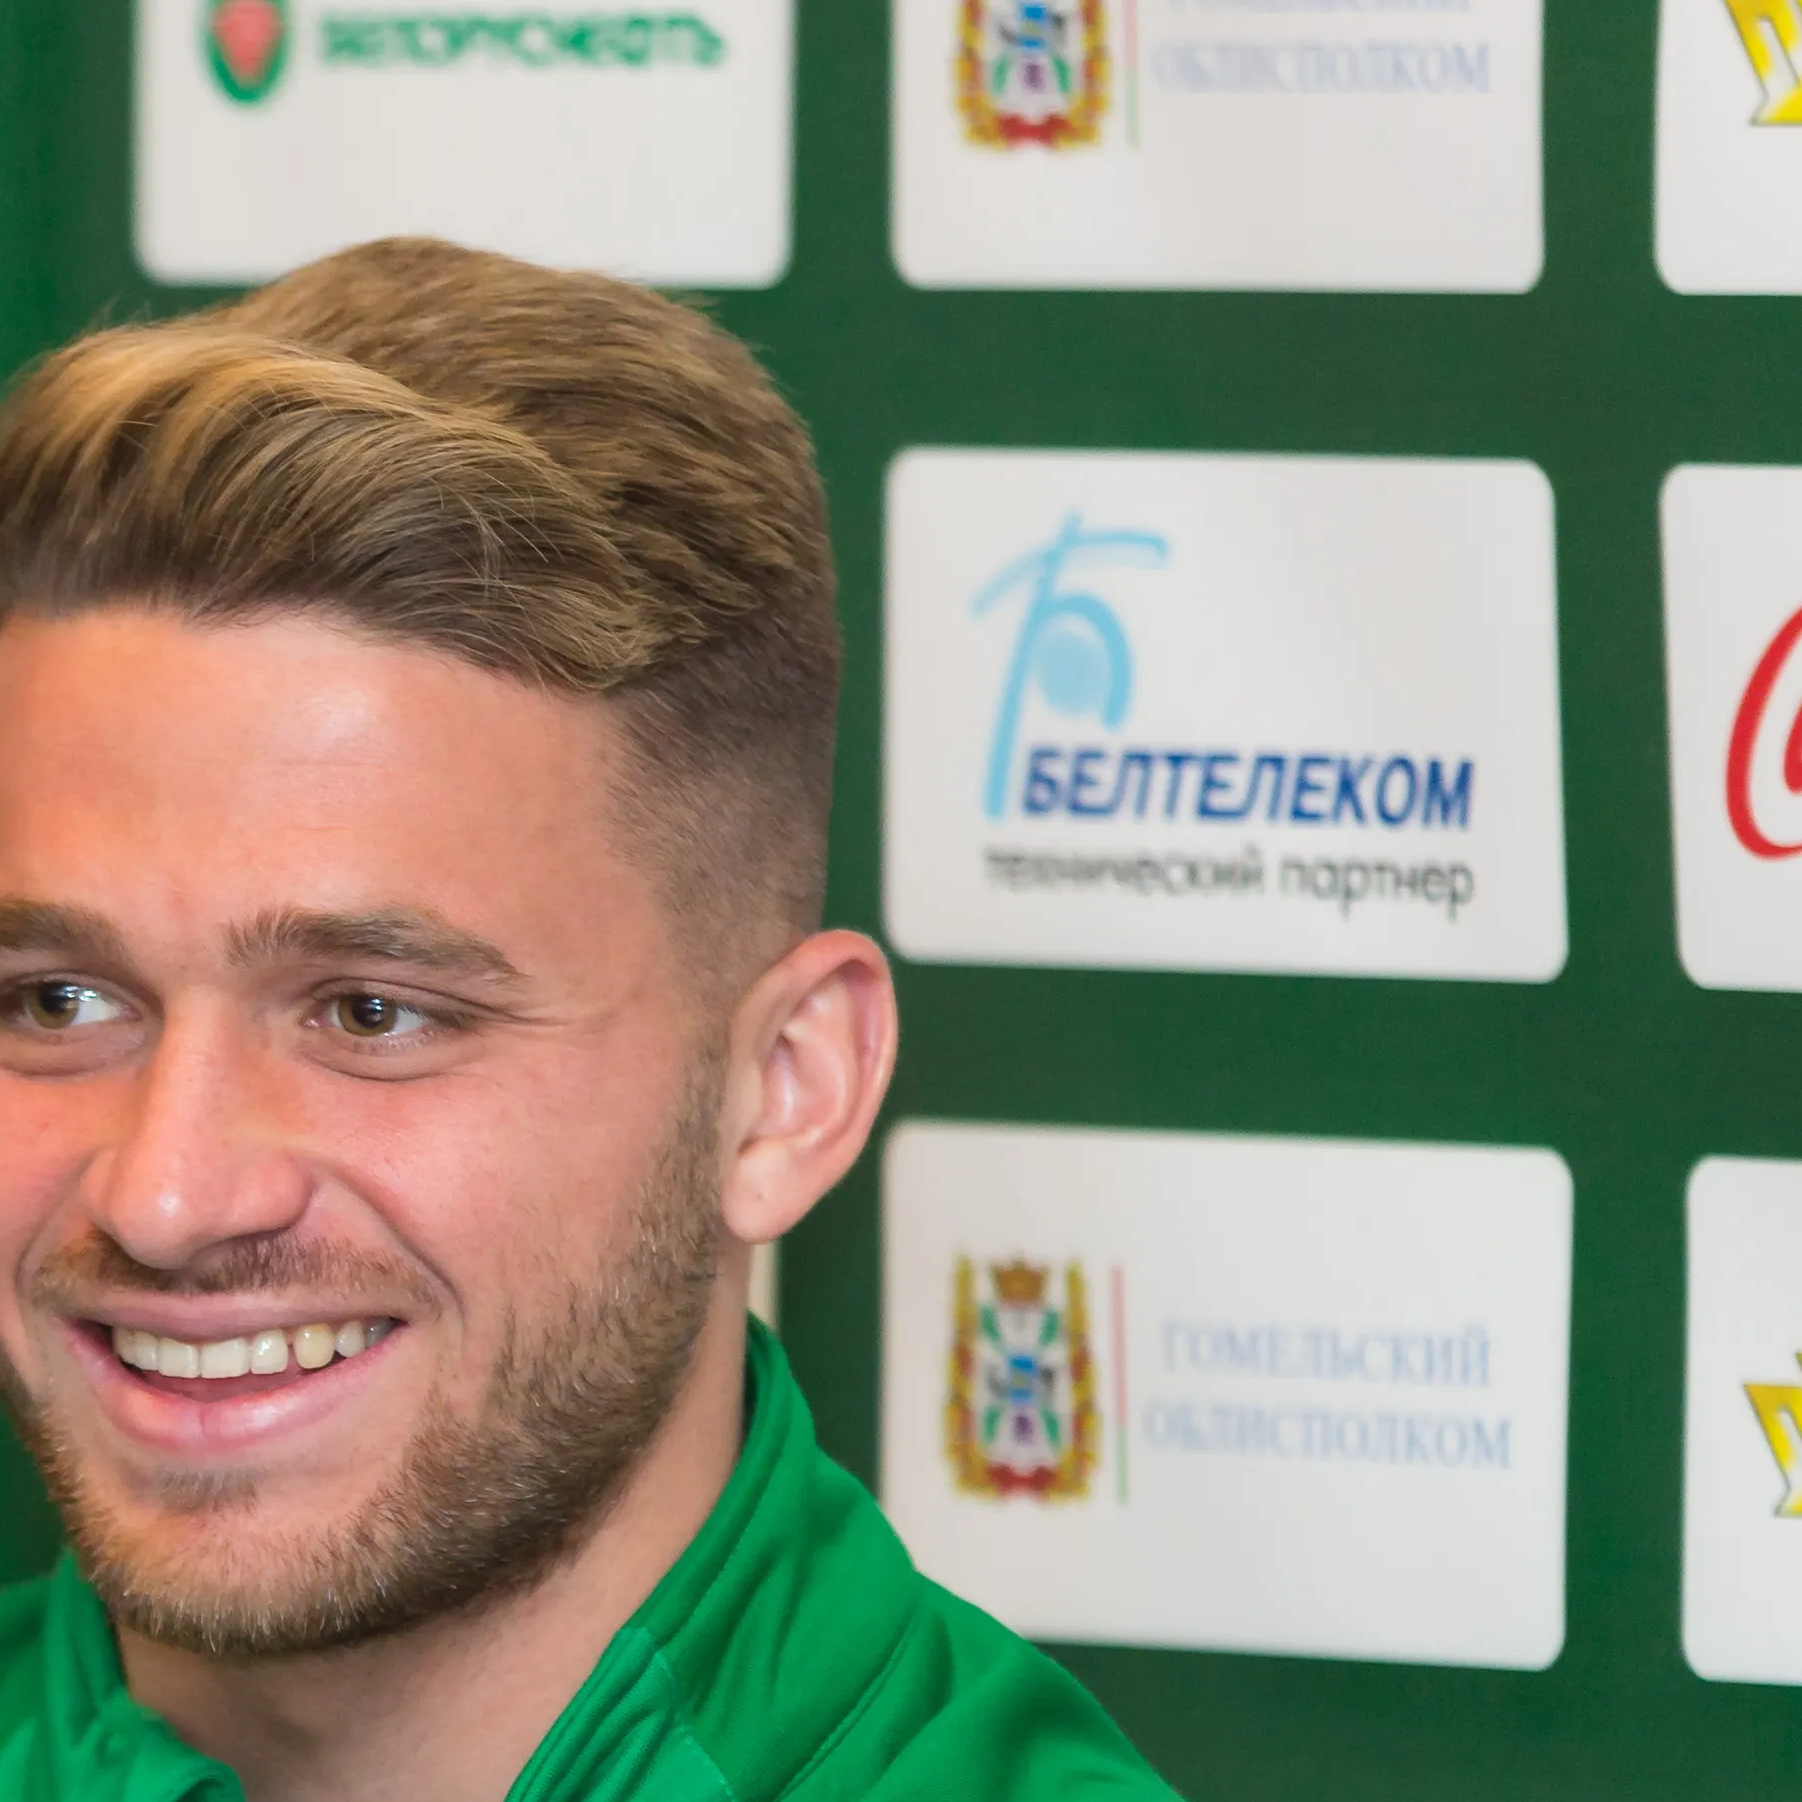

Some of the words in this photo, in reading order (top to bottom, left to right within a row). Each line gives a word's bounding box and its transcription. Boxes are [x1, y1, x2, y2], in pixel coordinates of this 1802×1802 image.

[1020, 746, 1476, 830] БЕЛТЕЛЕКОМ
[982, 844, 1265, 898] технический
[1279, 856, 1476, 921] партнер
[1160, 1319, 1493, 1388] ГОМЕЛЬСКИЙ
[1142, 1401, 1513, 1471] ОБЛИСПОЛКОМ
